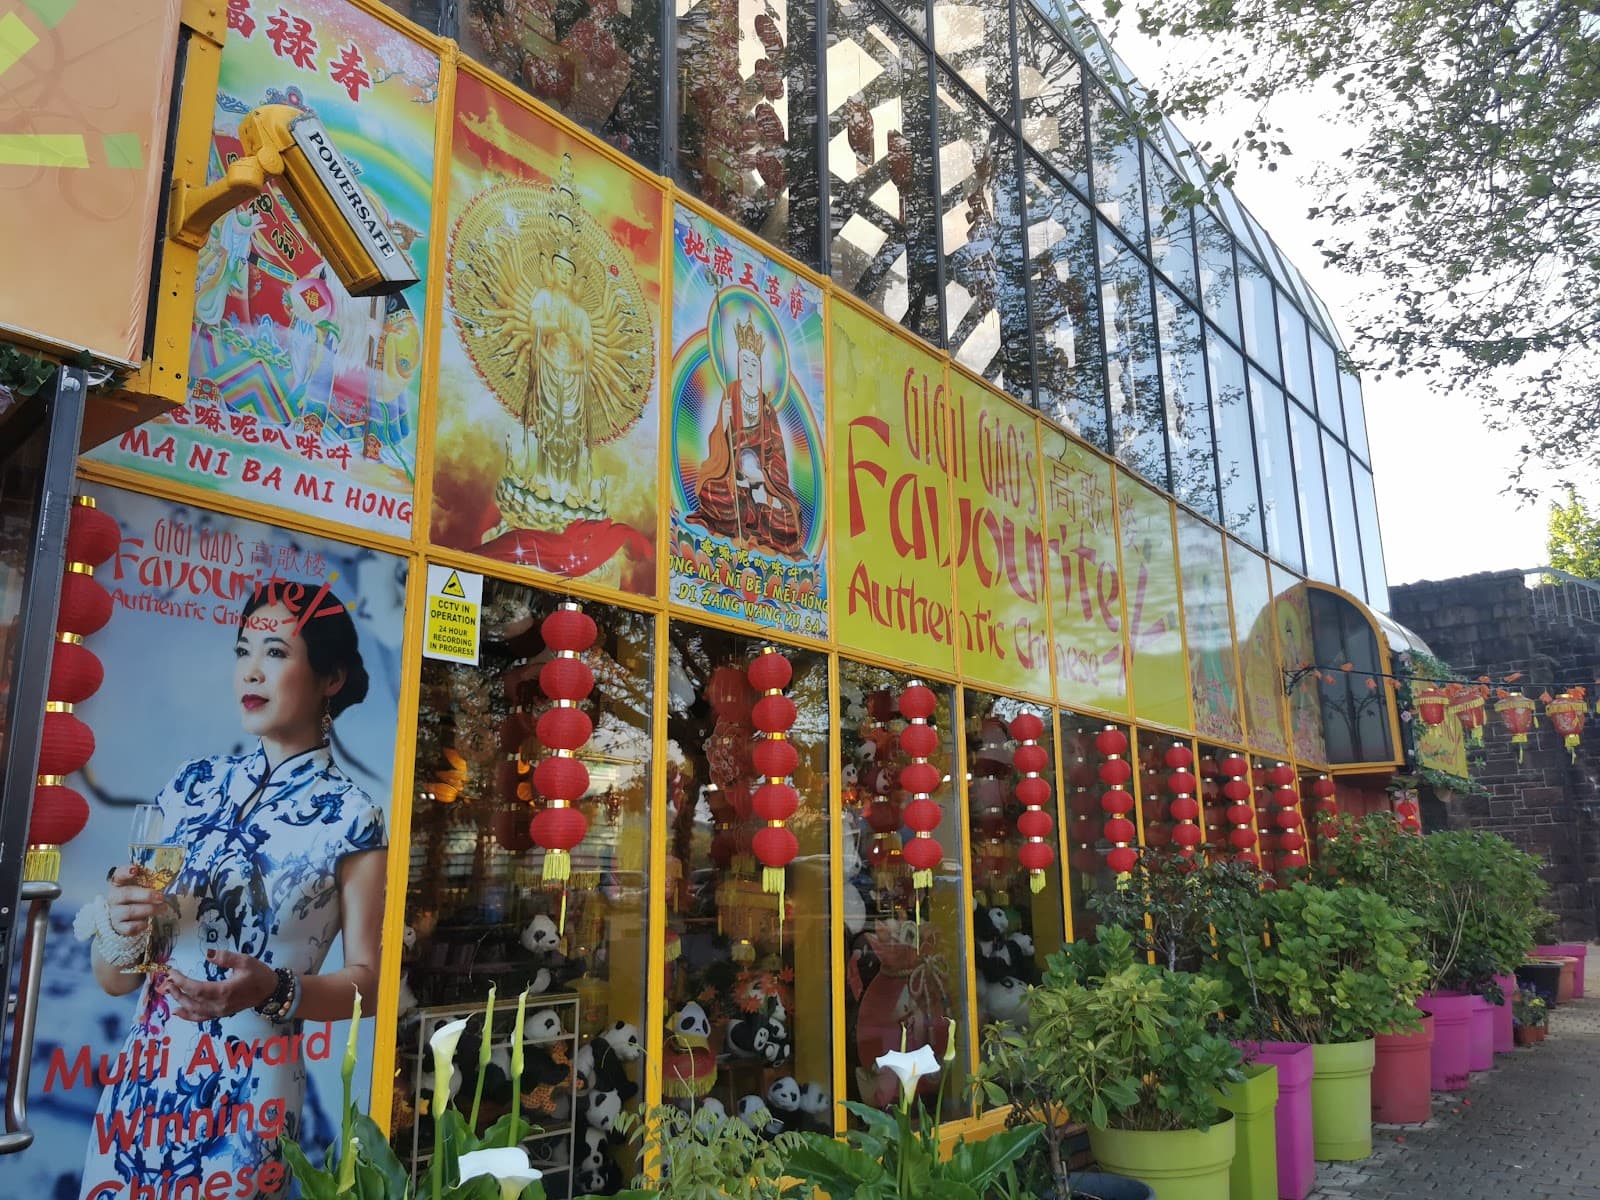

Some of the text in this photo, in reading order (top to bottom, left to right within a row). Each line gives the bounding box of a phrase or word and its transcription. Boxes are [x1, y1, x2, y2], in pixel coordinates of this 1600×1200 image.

[308, 130, 395, 260] POWERSAFE
[904, 367, 967, 484] GIGI
[119, 427, 414, 523] MA NI BA MI HONG
[154, 518, 191, 558] GIGI
[848, 415, 1120, 633] Favourite
[113, 537, 305, 611] Favourite
[111, 586, 279, 633] Authentic Chinese
[430, 609, 477, 626] OPERATION
[438, 599, 471, 614] CCTV IN
[439, 624, 468, 636] 24 HOUR
[677, 582, 821, 634] DI ZANG WANG PU SA
[848, 560, 1100, 687] Authentic Chinese
[430, 641, 475, 657] IN PROGRESS
[433, 633, 473, 647] RECORDING
[44, 1020, 332, 1093] Multi Award
[95, 1094, 287, 1156] Winning
